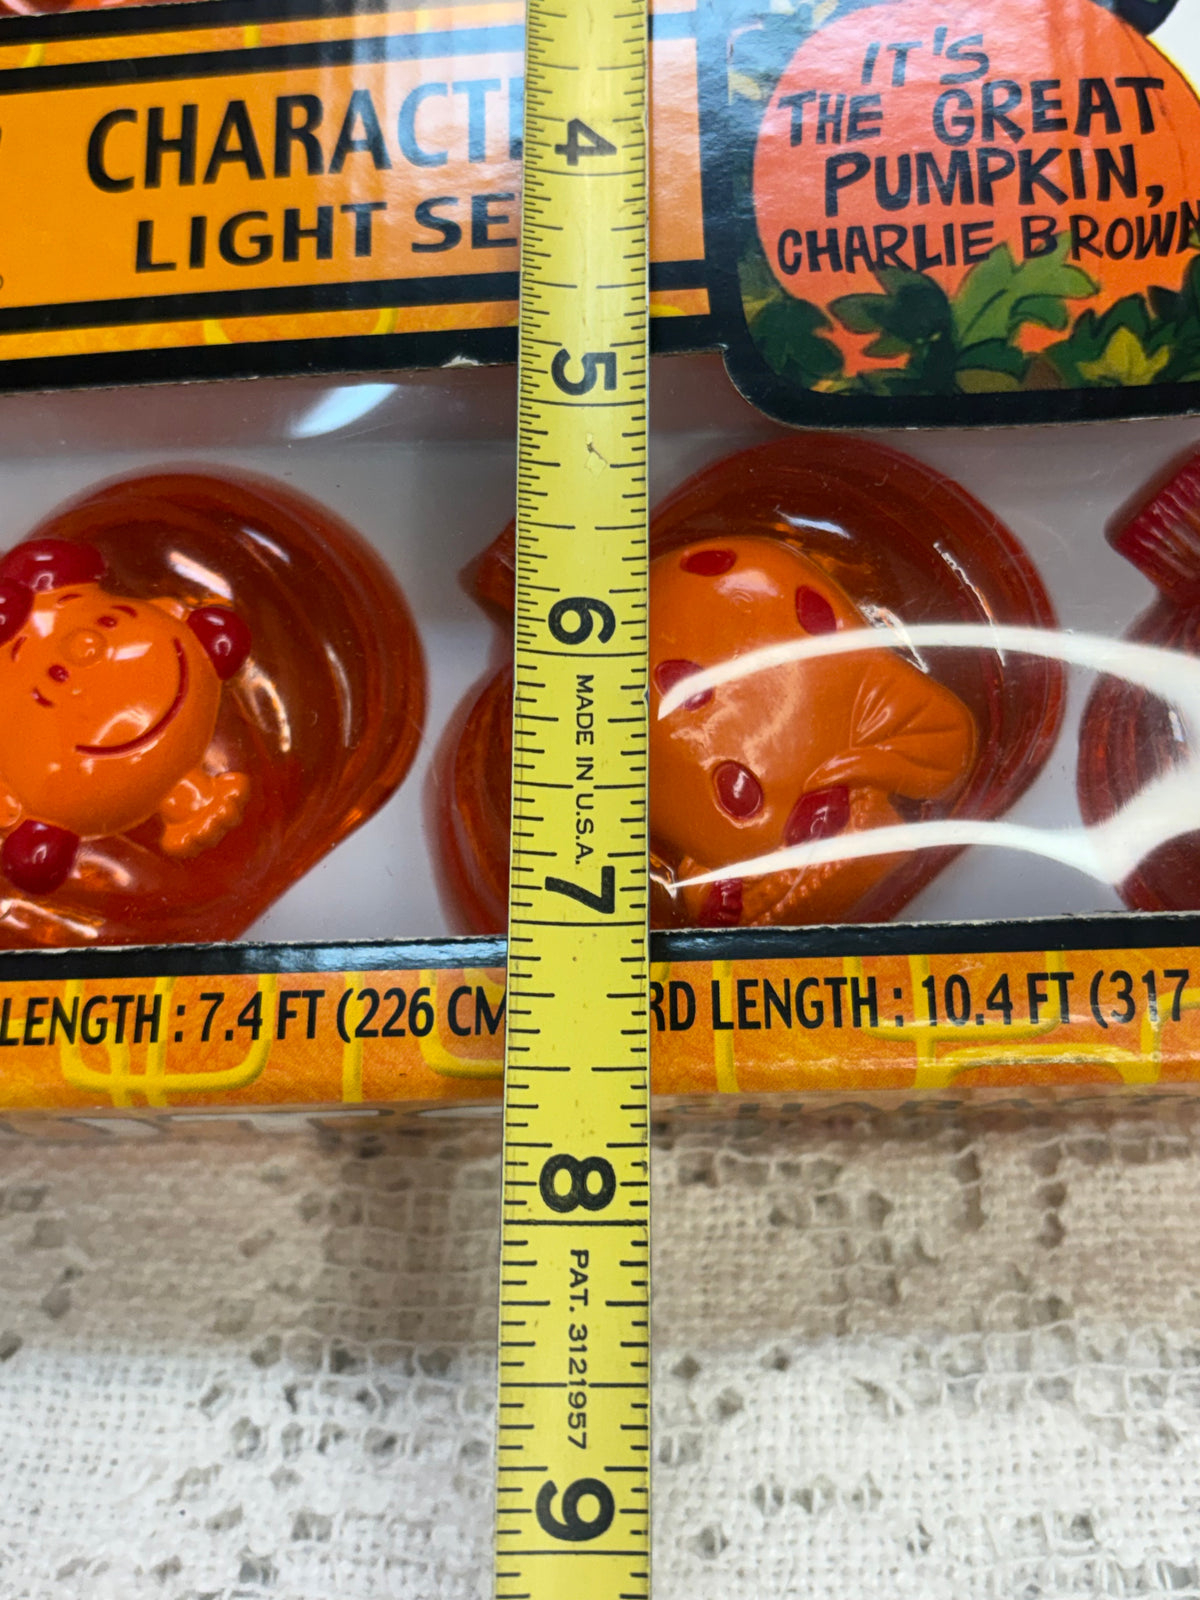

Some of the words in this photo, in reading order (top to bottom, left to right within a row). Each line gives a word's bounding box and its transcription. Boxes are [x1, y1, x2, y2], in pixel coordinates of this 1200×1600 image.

[861, 26, 990, 87] IT'S
[87, 76, 524, 193] CHARACT
[554, 117, 618, 166] 4
[777, 90, 884, 147] THE
[932, 77, 1165, 146] GREAT
[824, 143, 1165, 217] PUMPKIN,
[135, 201, 388, 273] LIGHT
[411, 192, 523, 253] SE
[777, 220, 994, 275] CHARLIE
[1020, 199, 1200, 261] BROWN
[551, 347, 617, 396] 5
[547, 596, 616, 645] 6
[575, 673, 595, 746] MADE
[575, 756, 595, 781] IN
[575, 792, 595, 866] U.S.A.
[544, 865, 616, 915] 7
[200, 991, 263, 1043] 7.4
[277, 989, 325, 1040] FT
[336, 987, 435, 1045] (226
[921, 973, 1014, 1028] 10.4
[1027, 970, 1076, 1026] FT
[1089, 969, 1190, 1030] (317
[539, 1153, 617, 1213] 8
[569, 1248, 589, 1313] PAT.
[566, 1323, 589, 1450] 3121957
[535, 1477, 616, 1542] 9
